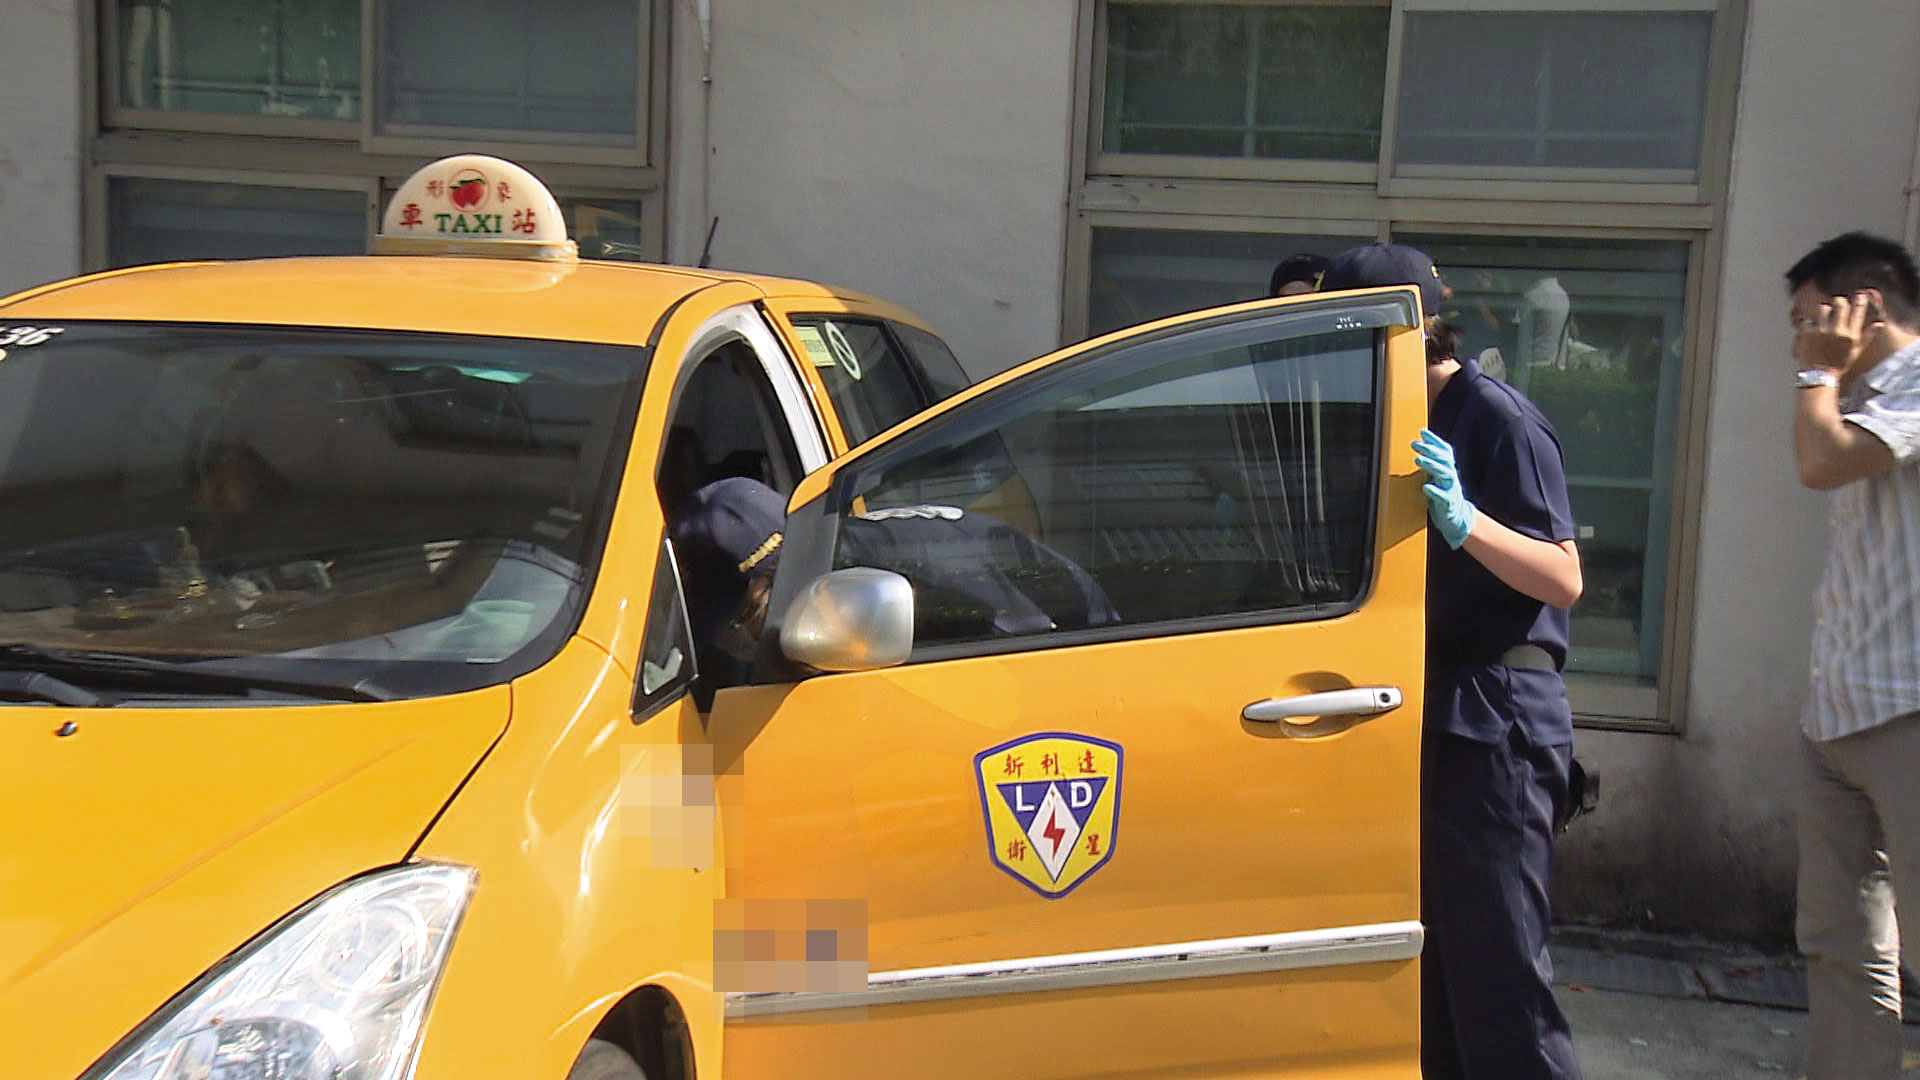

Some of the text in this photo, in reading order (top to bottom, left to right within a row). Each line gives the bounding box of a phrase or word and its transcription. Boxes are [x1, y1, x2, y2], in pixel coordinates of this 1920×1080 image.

[400, 203, 537, 233] 車 TAXI 站
[0, 326, 65, 345] 36
[1016, 782, 1092, 811] L D
